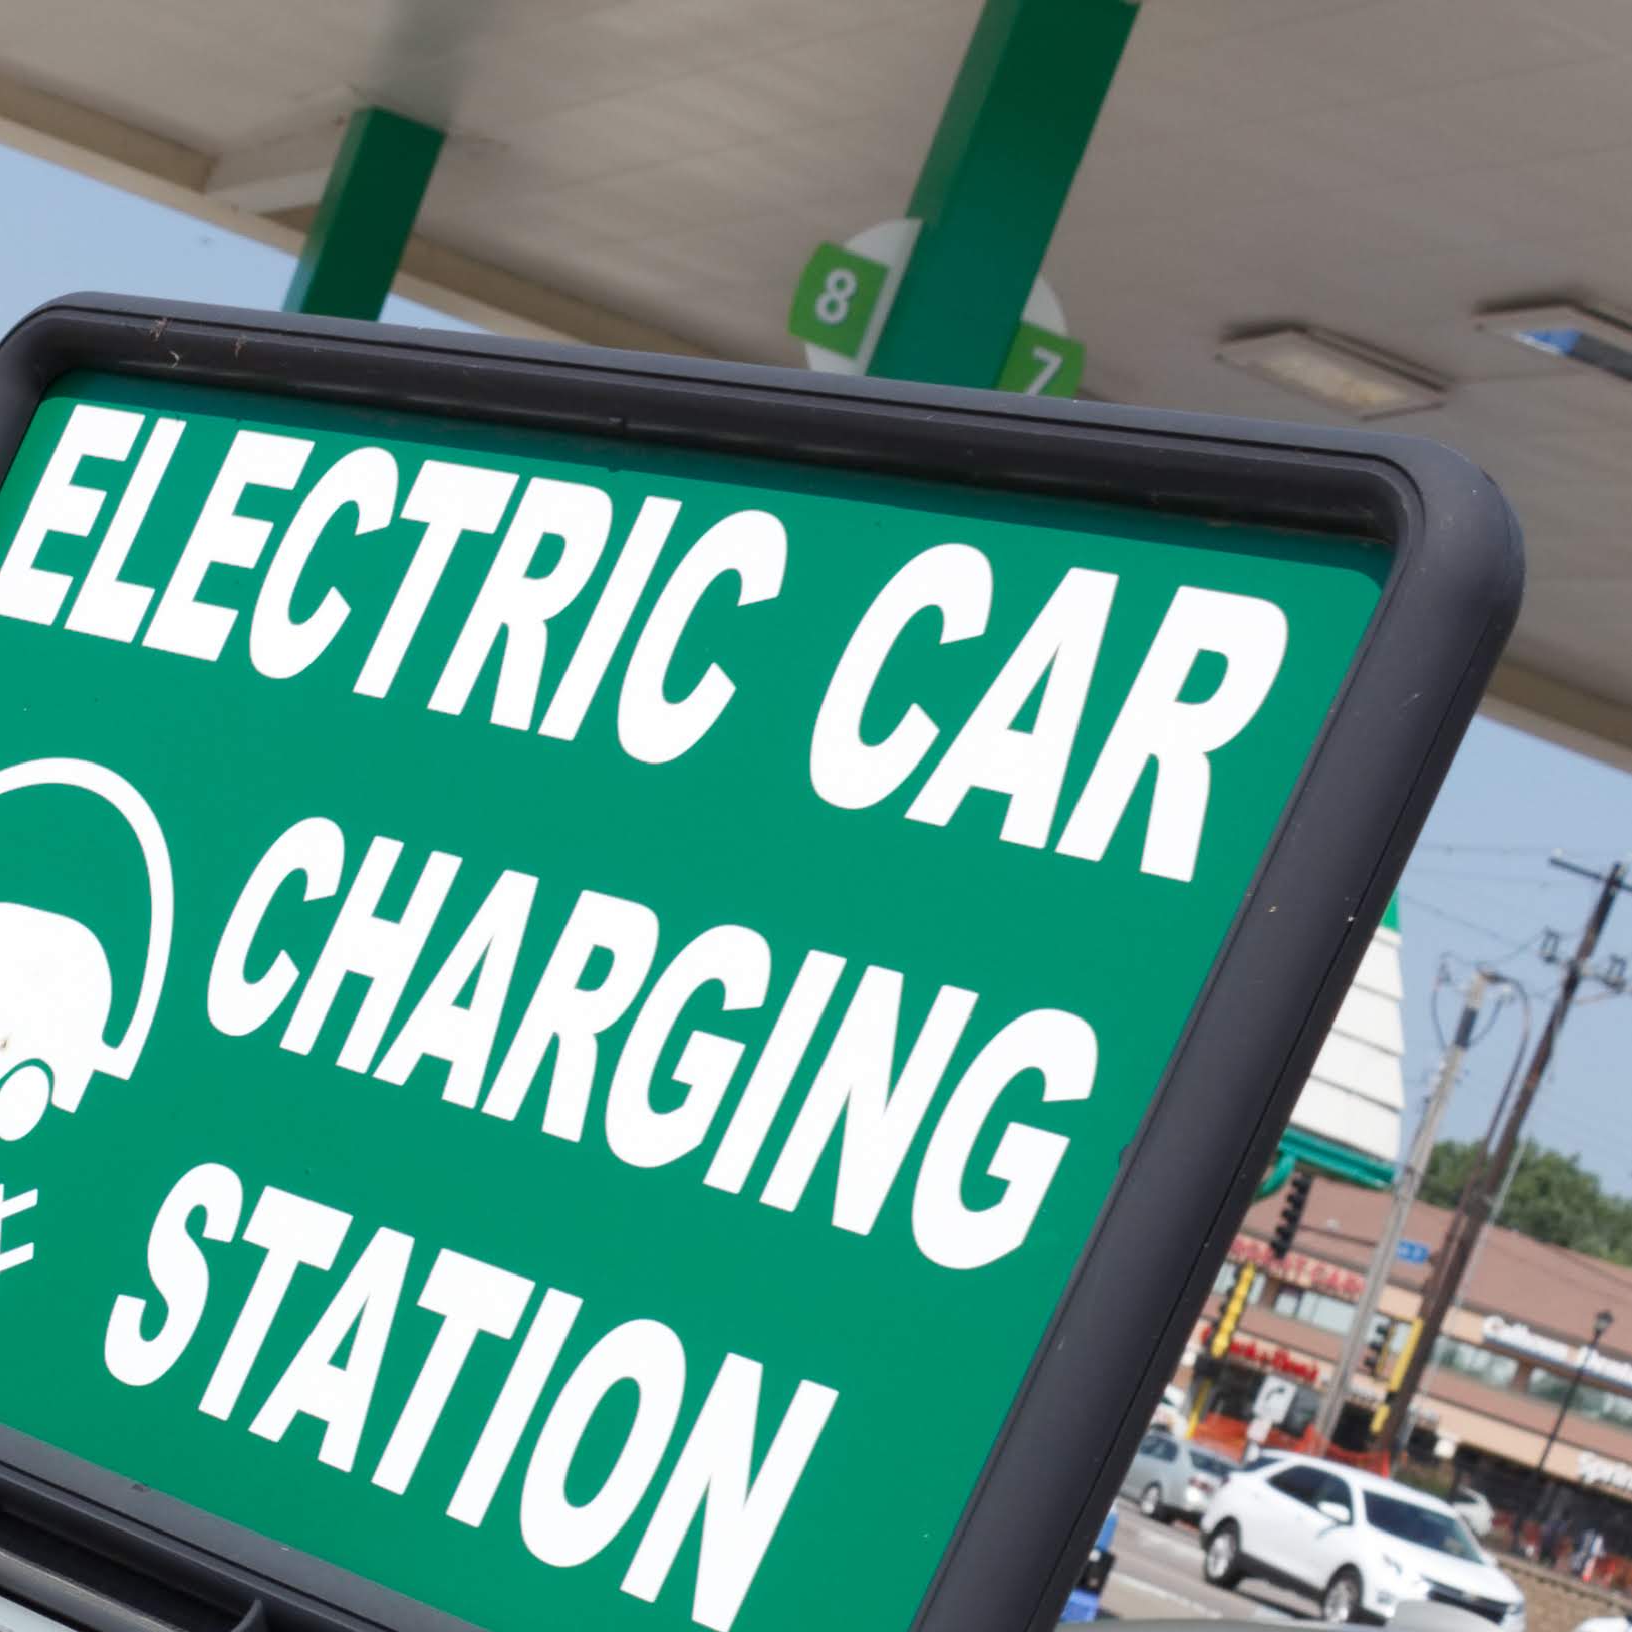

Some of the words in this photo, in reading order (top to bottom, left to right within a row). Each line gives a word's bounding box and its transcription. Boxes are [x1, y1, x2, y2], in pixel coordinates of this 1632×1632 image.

[814, 268, 859, 326] 8
[1030, 346, 1064, 395] 7
[809, 544, 1288, 882] CAR
[208, 817, 1097, 1270] CHARGING
[105, 1164, 838, 1632] STATION
